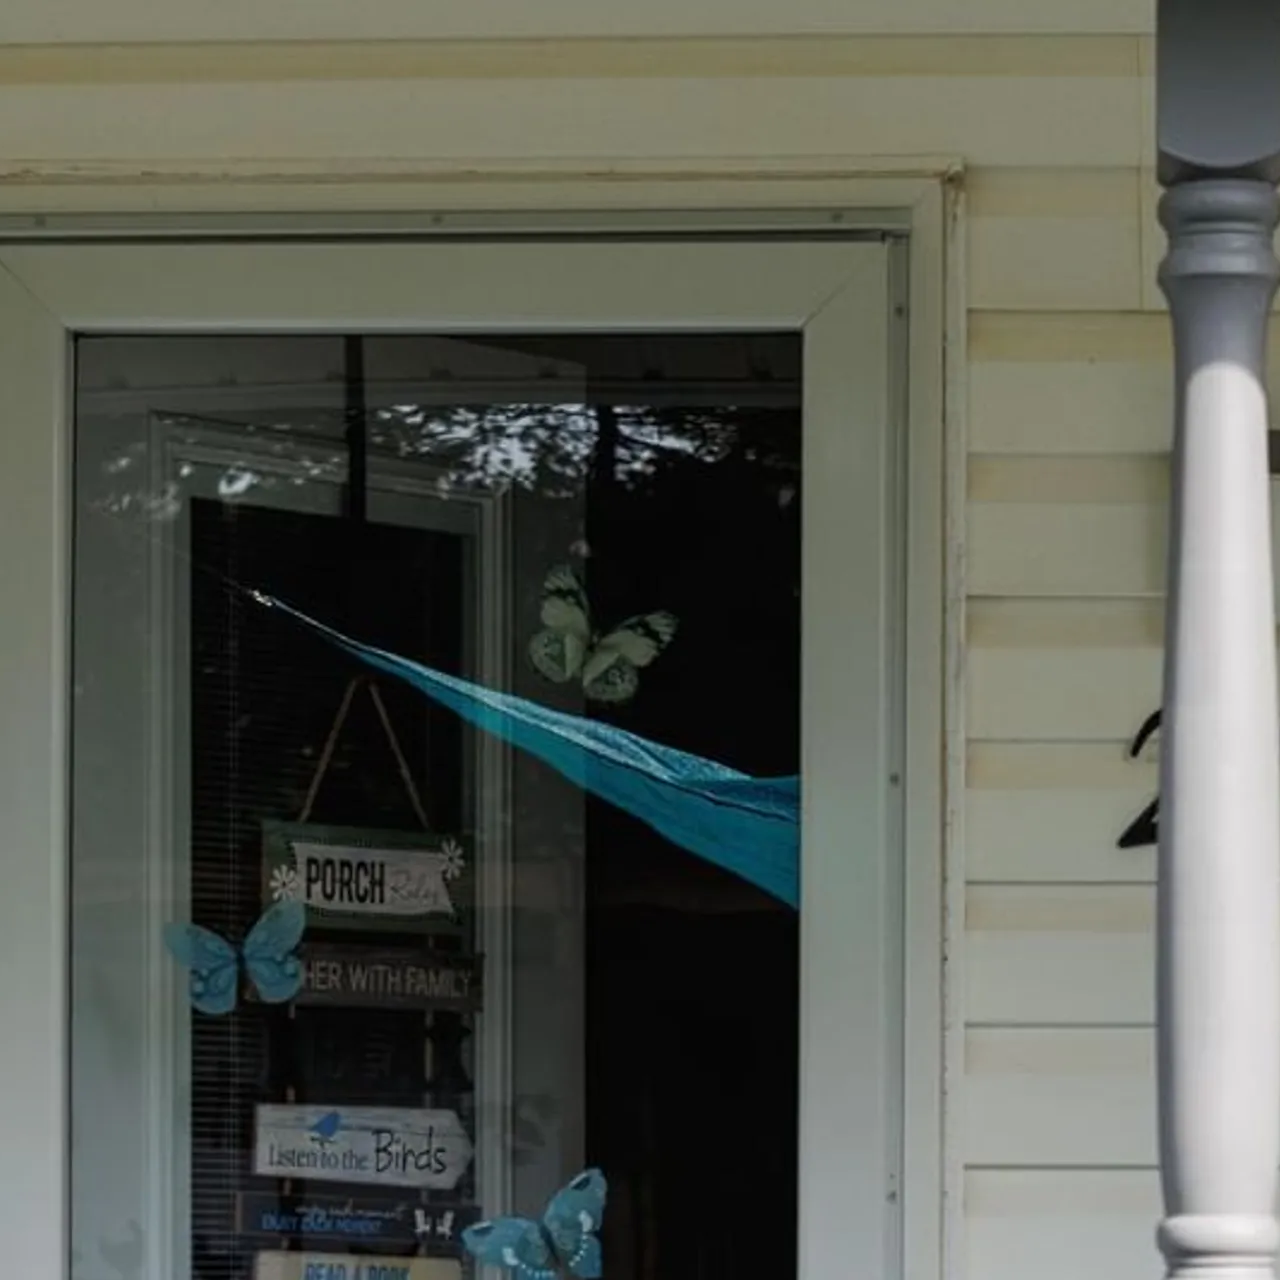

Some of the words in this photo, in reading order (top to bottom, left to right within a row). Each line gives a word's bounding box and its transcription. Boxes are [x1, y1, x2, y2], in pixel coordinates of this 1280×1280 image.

[306, 857, 385, 904] PORCH
[349, 963, 402, 995] WITH
[406, 965, 472, 998] FAMILY
[268, 1144, 316, 1169] Listen
[318, 1151, 339, 1169] to
[341, 1148, 369, 1171] the
[371, 1126, 447, 1175] Birds
